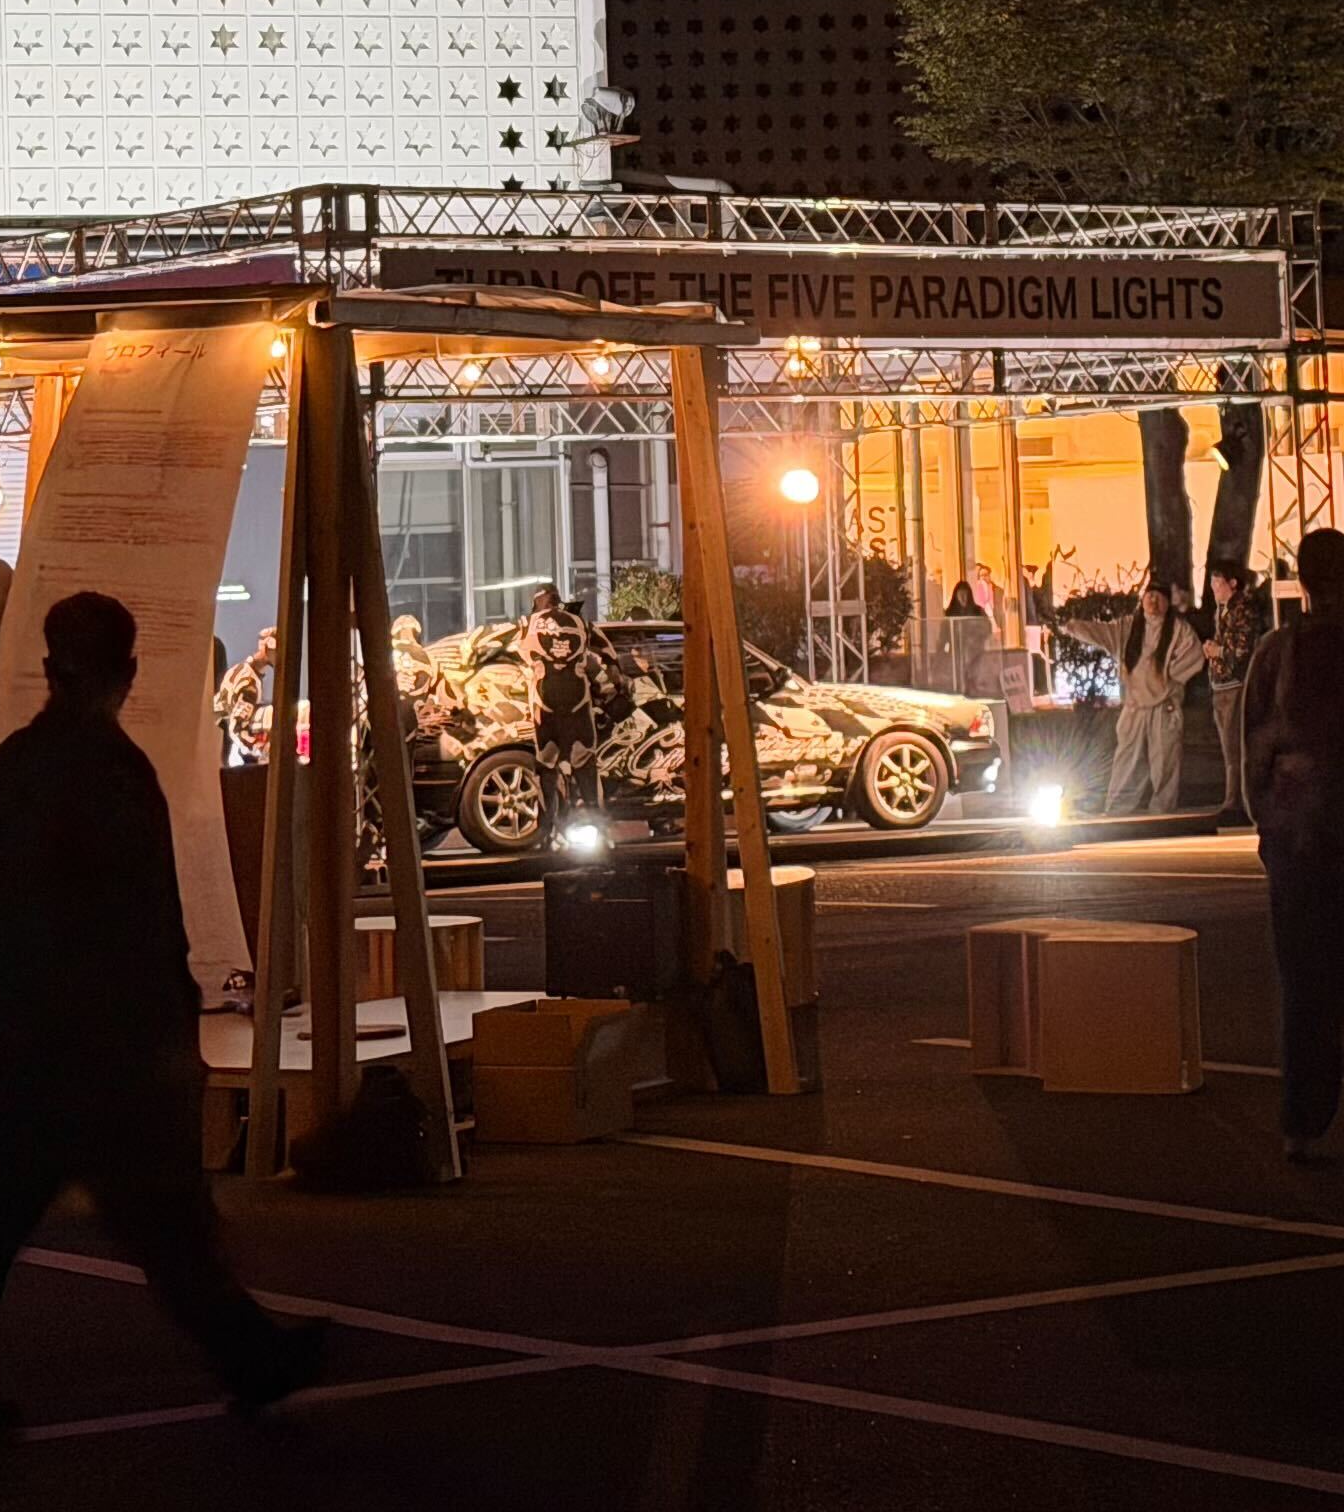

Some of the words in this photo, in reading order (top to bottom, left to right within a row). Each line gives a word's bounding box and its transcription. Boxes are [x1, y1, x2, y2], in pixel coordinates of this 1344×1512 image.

[668, 272, 755, 317] THE
[768, 273, 856, 319] FIVE
[870, 274, 1078, 321] PARADIGM
[1090, 276, 1226, 322] LIGHTS
